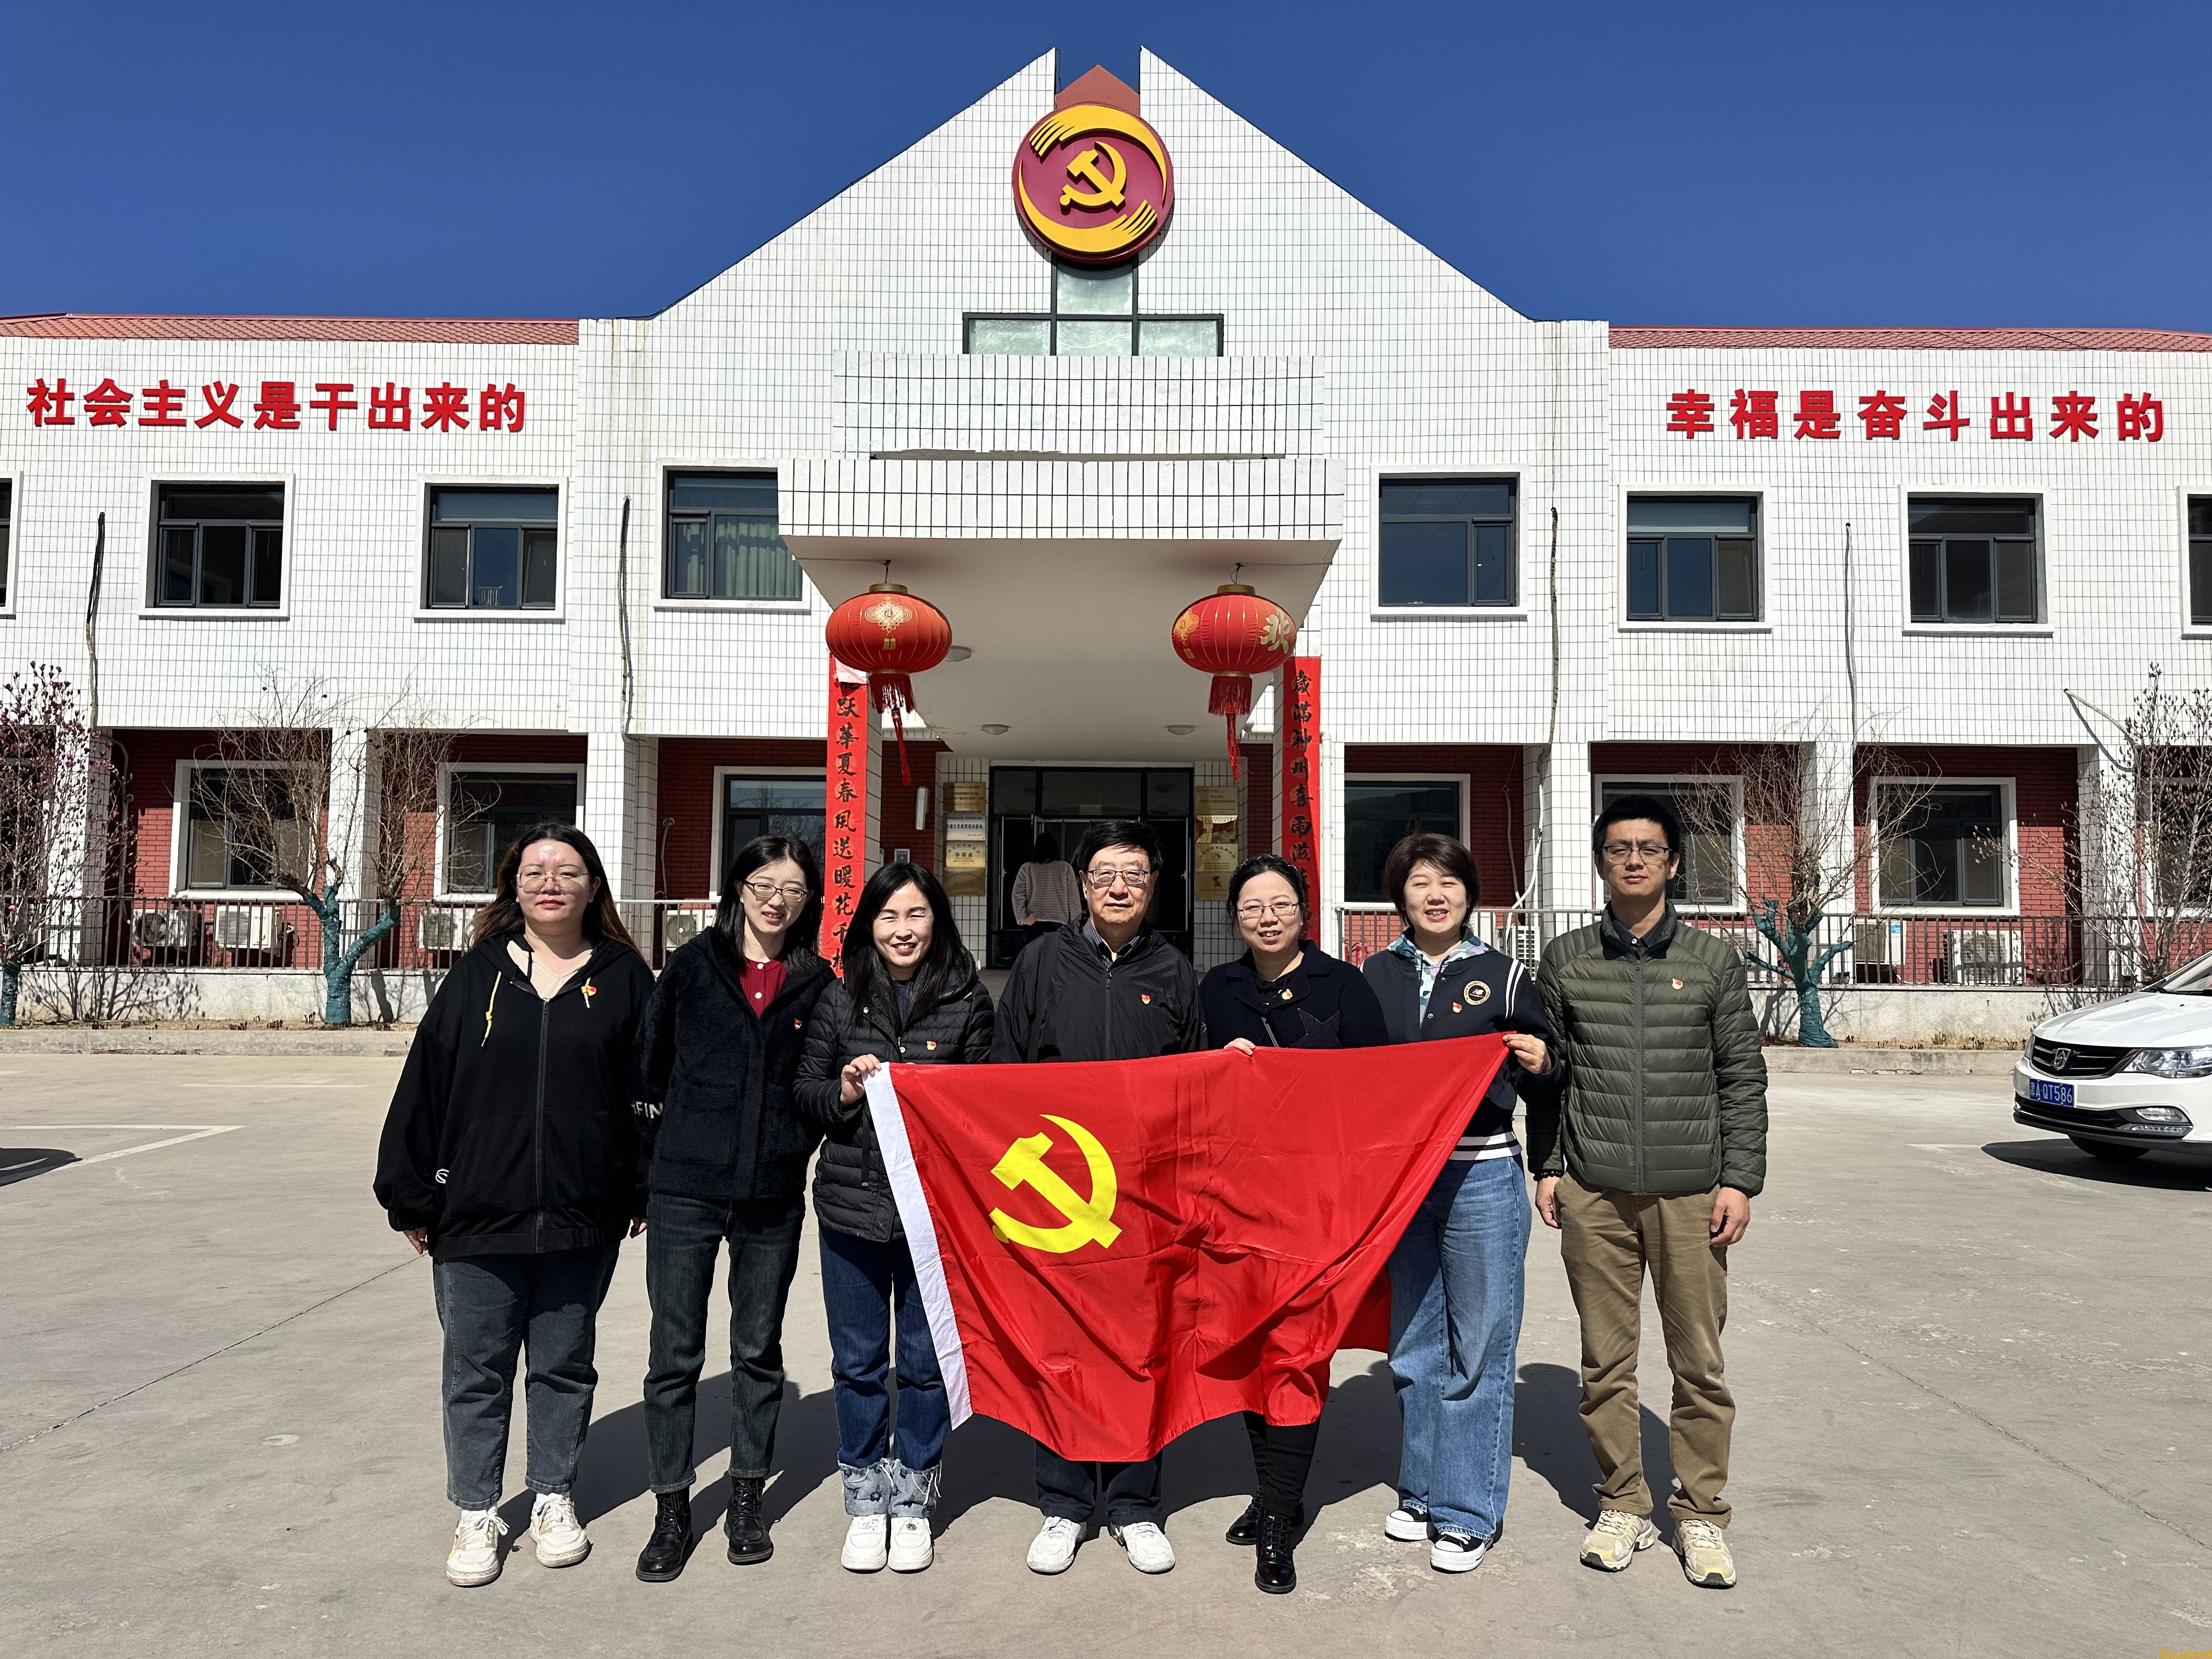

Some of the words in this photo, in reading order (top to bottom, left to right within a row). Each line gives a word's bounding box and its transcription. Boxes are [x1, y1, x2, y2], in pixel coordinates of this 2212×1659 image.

[27, 379, 525, 432] 社会主义是干出来的
[1666, 388, 2164, 442] 幸福是奋斗出来的
